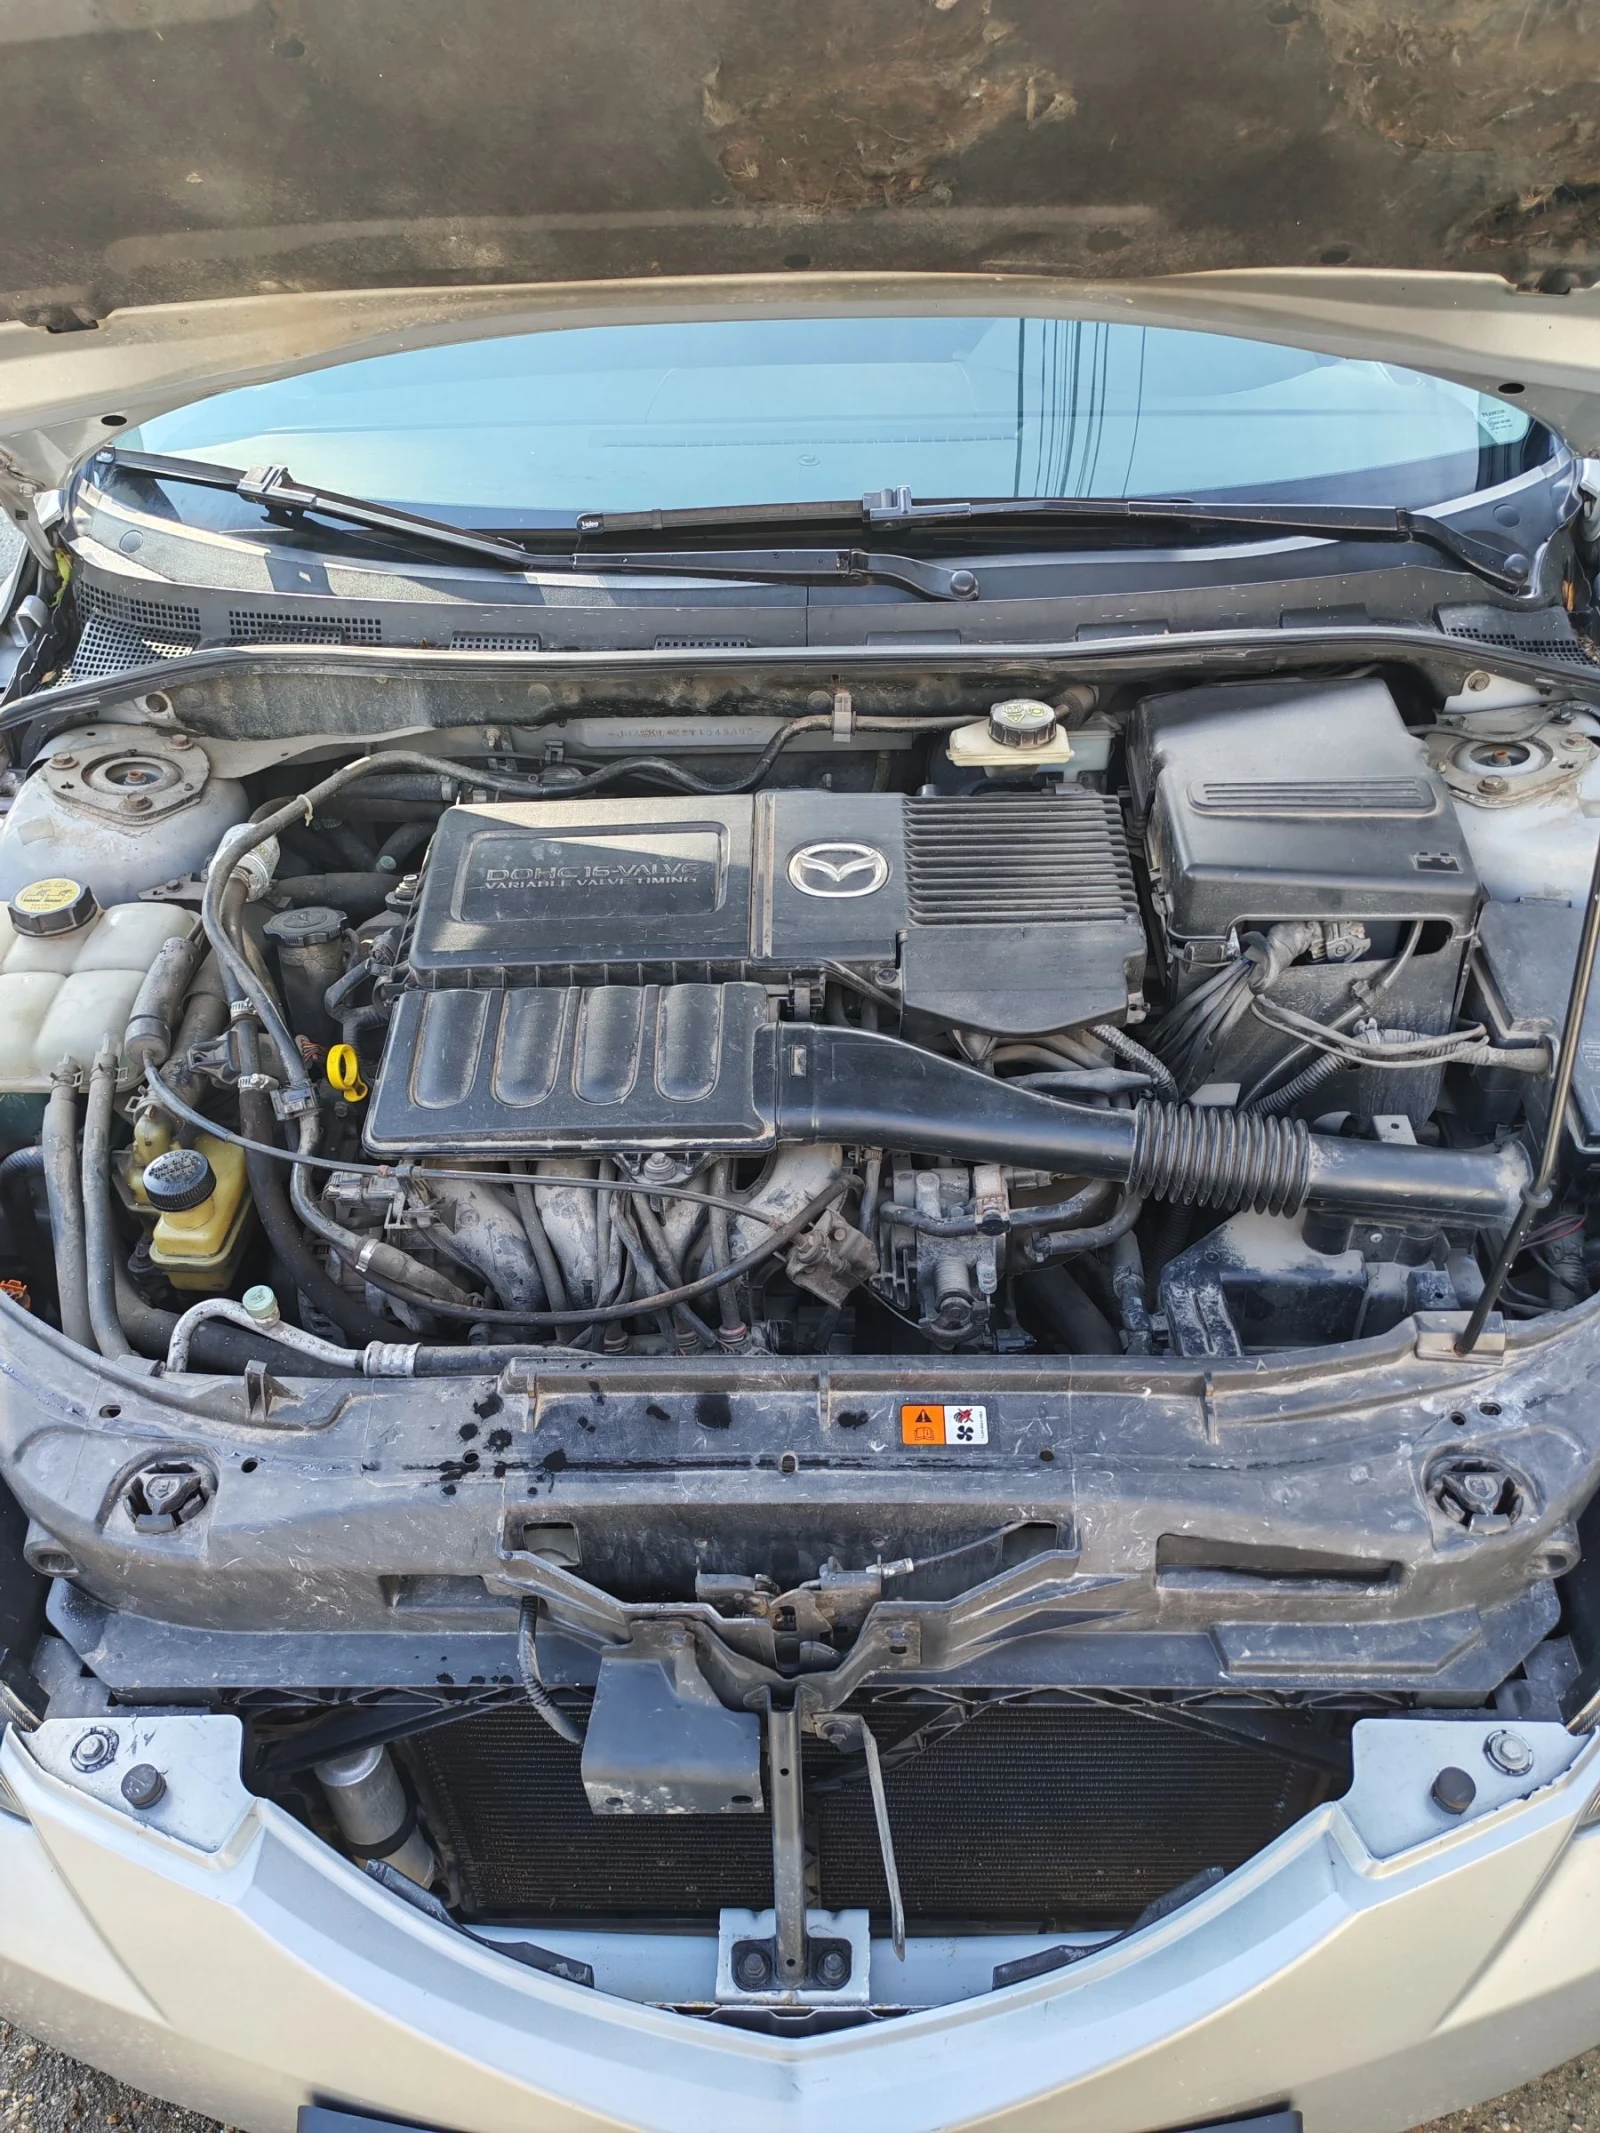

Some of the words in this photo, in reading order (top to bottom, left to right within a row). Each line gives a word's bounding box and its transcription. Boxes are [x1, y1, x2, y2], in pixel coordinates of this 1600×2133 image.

[487, 866, 580, 881] DOHC
[584, 863, 698, 877] 16-VALVE
[637, 876, 697, 884] TIMING
